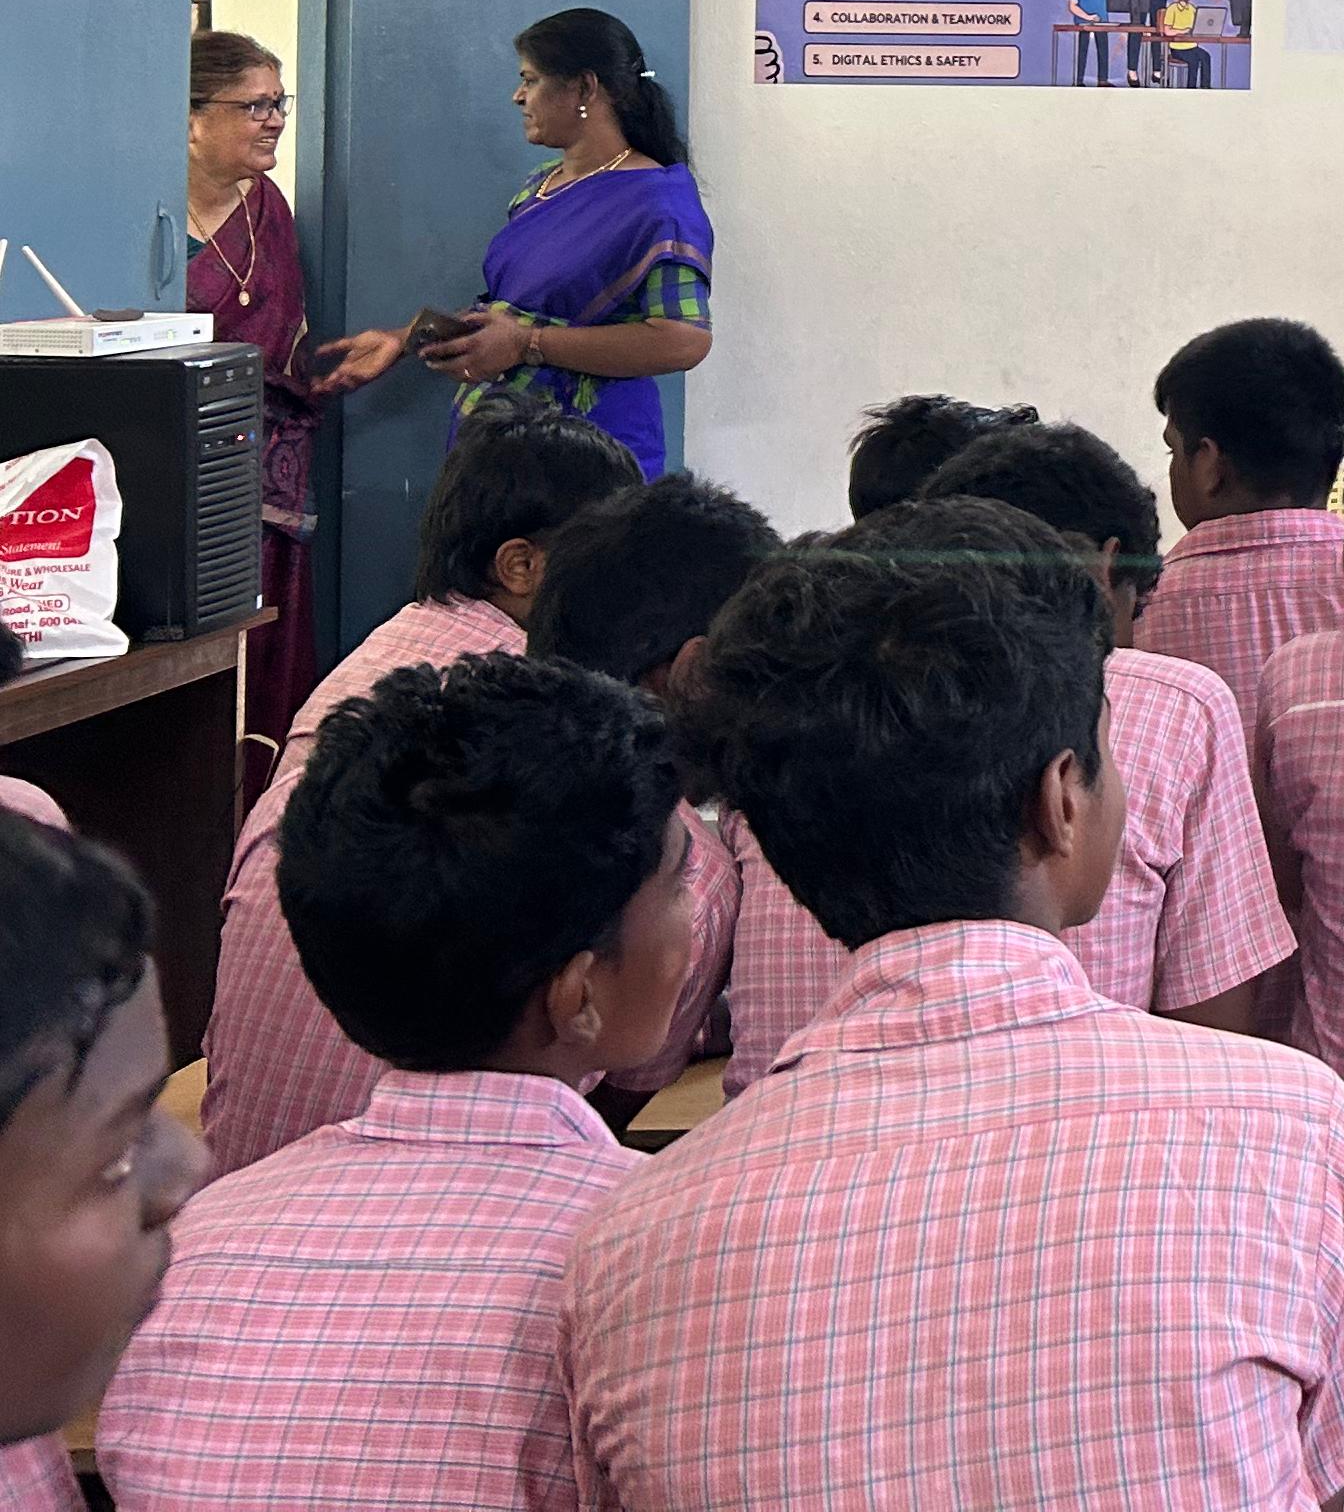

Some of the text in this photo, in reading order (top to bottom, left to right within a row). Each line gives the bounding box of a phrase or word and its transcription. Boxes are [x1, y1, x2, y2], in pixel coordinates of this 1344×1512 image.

[813, 12, 1012, 25] 4. COLLABORATION & TEAMWORK
[813, 54, 981, 67] 5. DIGITAL ETHICS & SAFETY
[0, 540, 62, 556] Statement
[37, 563, 92, 576] WHOLESALE
[10, 578, 44, 592] Wear
